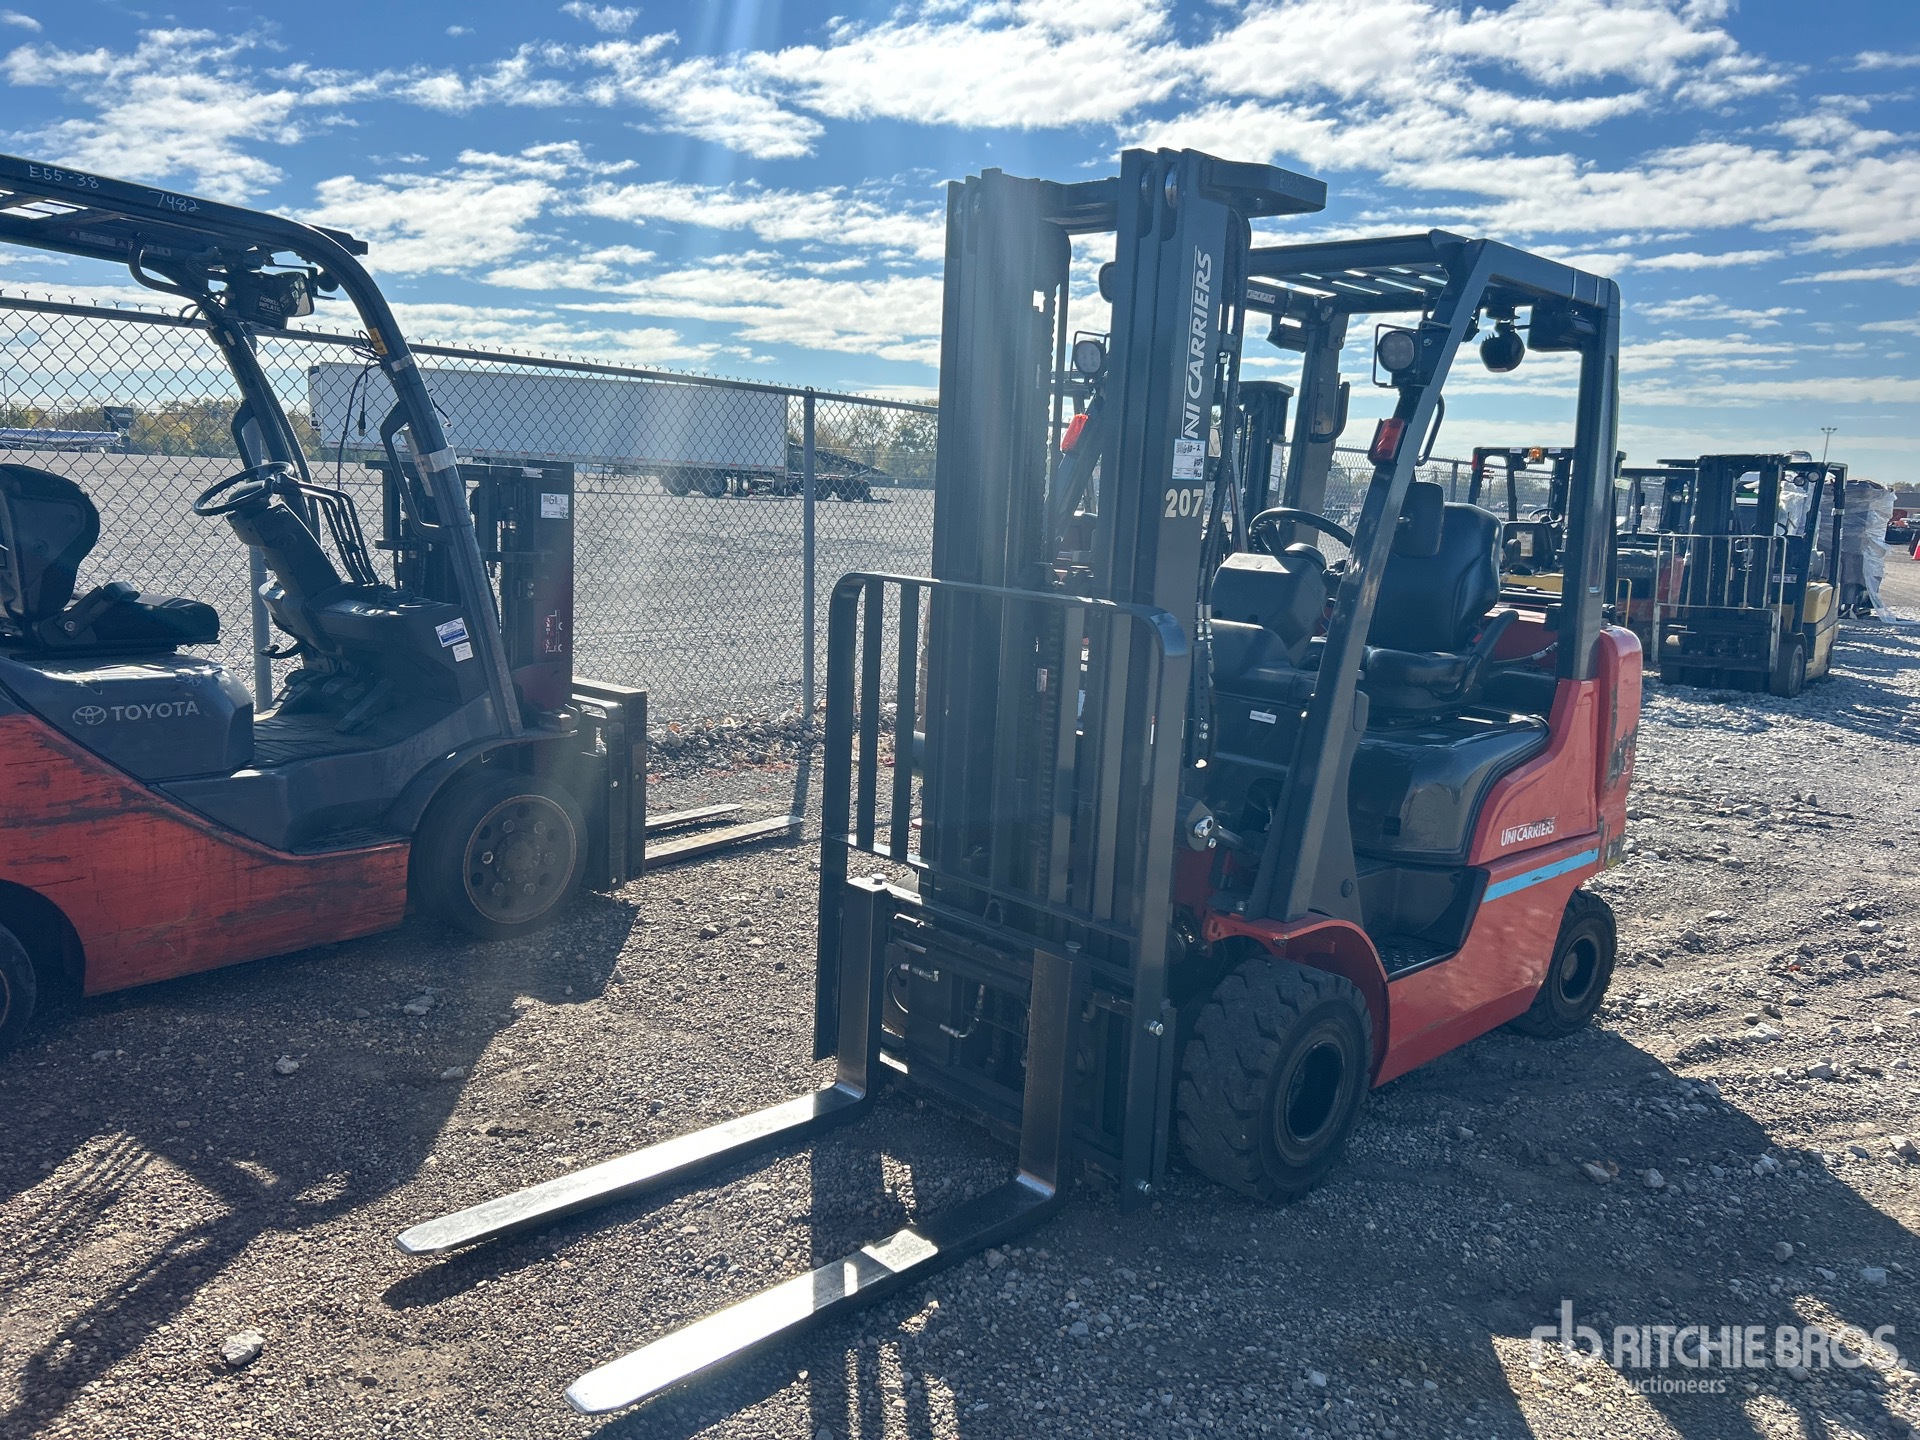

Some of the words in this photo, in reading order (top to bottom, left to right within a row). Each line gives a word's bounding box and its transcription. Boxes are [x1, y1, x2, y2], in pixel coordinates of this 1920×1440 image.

[29, 165, 100, 189] E55-38
[147, 191, 200, 212] 7482
[1181, 245, 1212, 439] NICARRIERS
[1164, 488, 1204, 517] 207
[110, 700, 200, 722] TOYOTA
